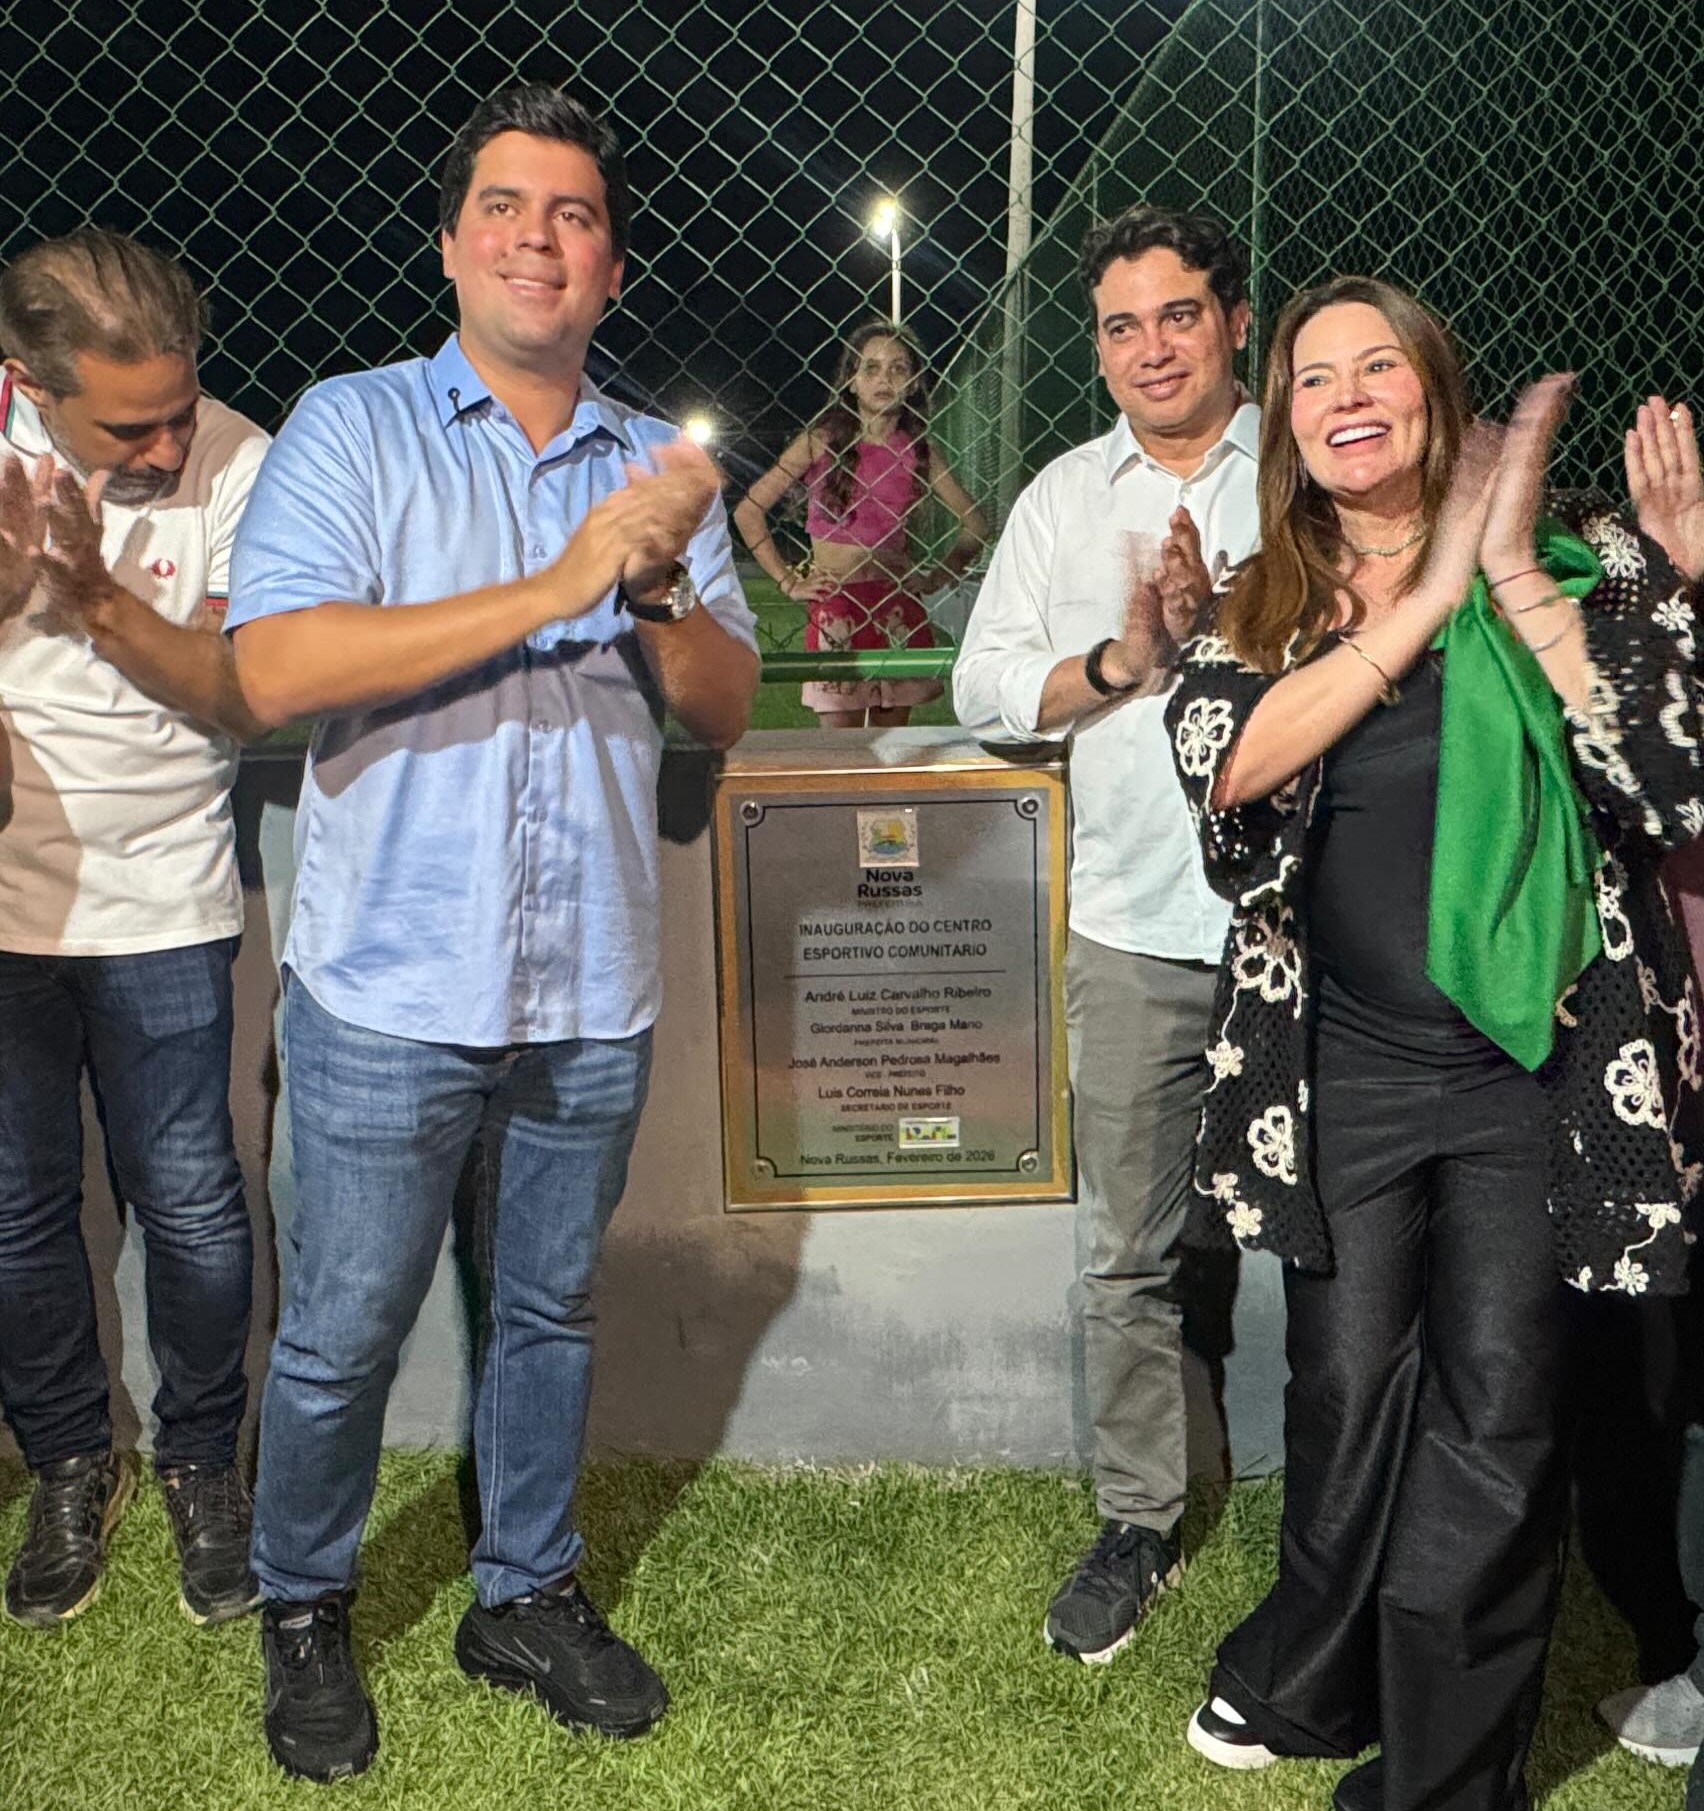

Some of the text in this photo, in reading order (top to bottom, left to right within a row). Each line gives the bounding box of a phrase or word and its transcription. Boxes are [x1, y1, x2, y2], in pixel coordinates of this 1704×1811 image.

[866, 869, 914, 883] Nova
[857, 884, 923, 898] Russas
[909, 921, 930, 933] DO
[933, 919, 993, 932] CENTRO
[803, 946, 884, 960] ESPORTIVO
[805, 986, 991, 1003] André Luiz Carvalho Ribeiro
[852, 1005, 950, 1015] MINISTRO DO ESPORTE
[810, 1022, 872, 1034] Giordanna
[876, 1020, 904, 1033] Silva
[911, 1020, 946, 1033] Braga
[789, 1052, 1000, 1069] José Anderson Pedrosa Magalhães
[847, 1086, 890, 1098] Correia
[894, 1085, 932, 1097] Nunes
[936, 1084, 965, 1096] Filho
[897, 1102, 909, 1111] DE
[912, 1102, 952, 1110] ESPORTE
[801, 1153, 832, 1165] Nova
[887, 1151, 943, 1164] Fevereiro
[947, 1151, 961, 1163] de
